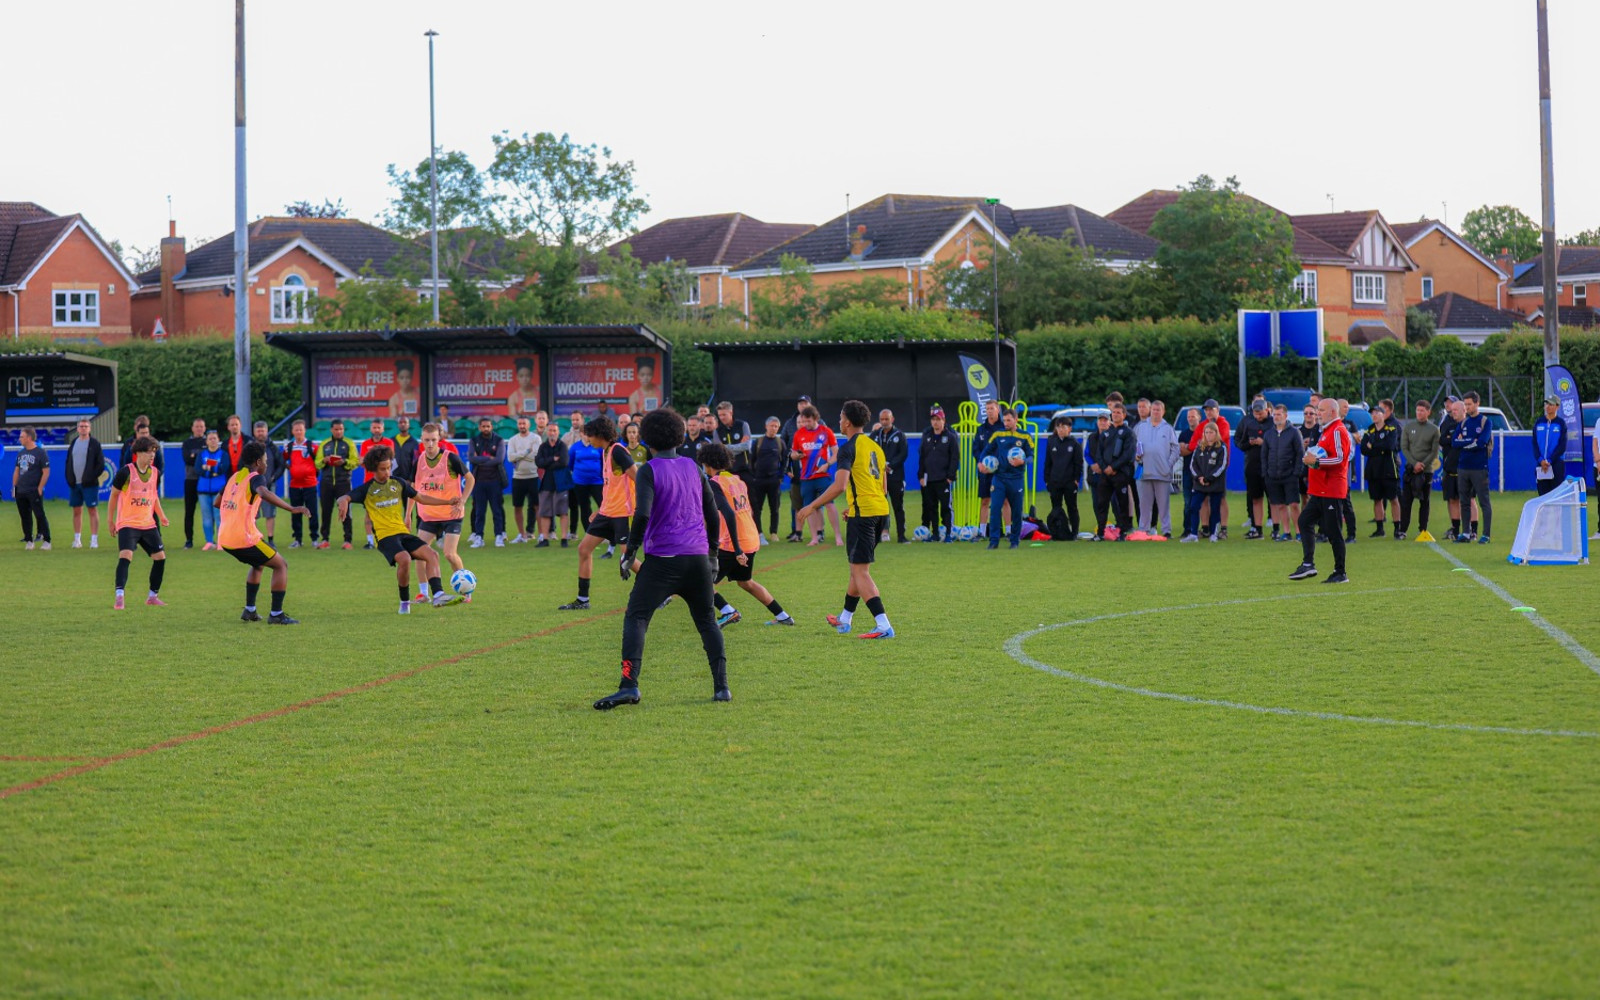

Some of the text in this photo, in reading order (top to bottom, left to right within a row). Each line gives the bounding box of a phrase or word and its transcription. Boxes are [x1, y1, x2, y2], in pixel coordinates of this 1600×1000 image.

[366, 371, 394, 384] FREE
[485, 369, 513, 382] FREE
[605, 368, 634, 381] FREE
[319, 385, 376, 399] WORKOUT
[437, 383, 496, 397] WORKOUT
[556, 382, 616, 395] WORKOUT
[869, 451, 880, 480] 4
